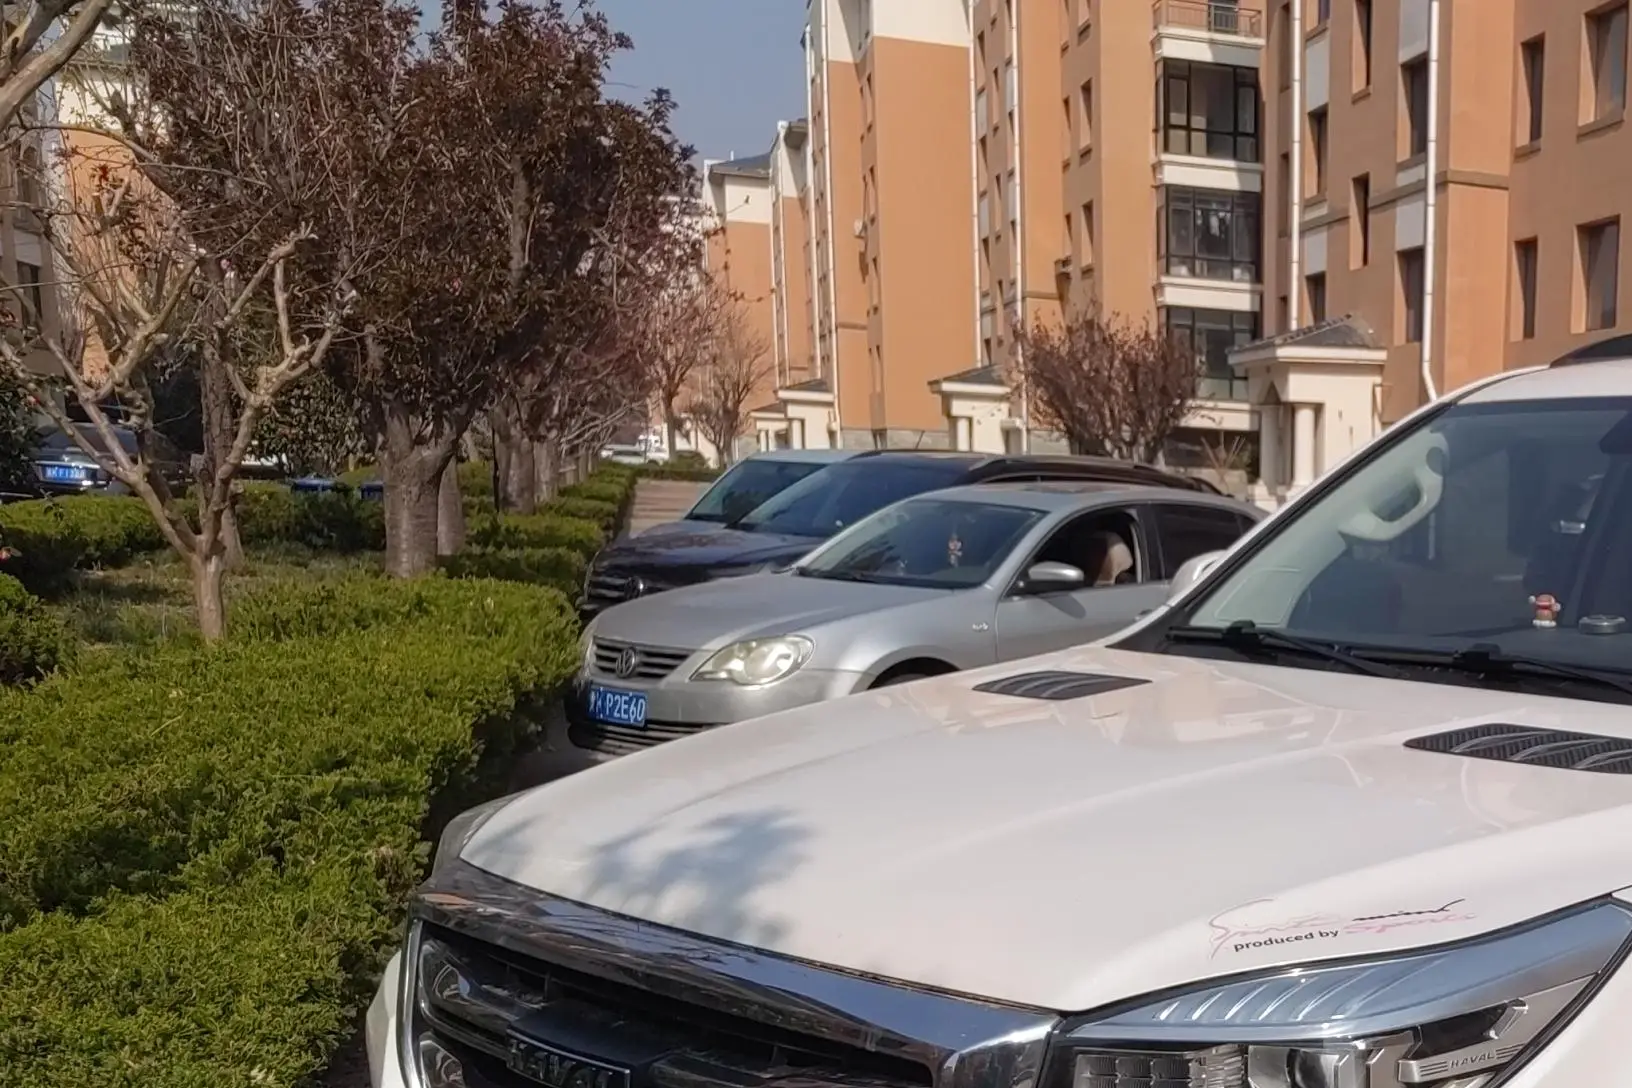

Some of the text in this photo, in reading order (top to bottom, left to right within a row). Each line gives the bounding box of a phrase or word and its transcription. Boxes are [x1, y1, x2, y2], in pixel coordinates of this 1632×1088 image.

[1233, 929, 1339, 952] produced by
[1450, 1051, 1496, 1069] HAVAL
